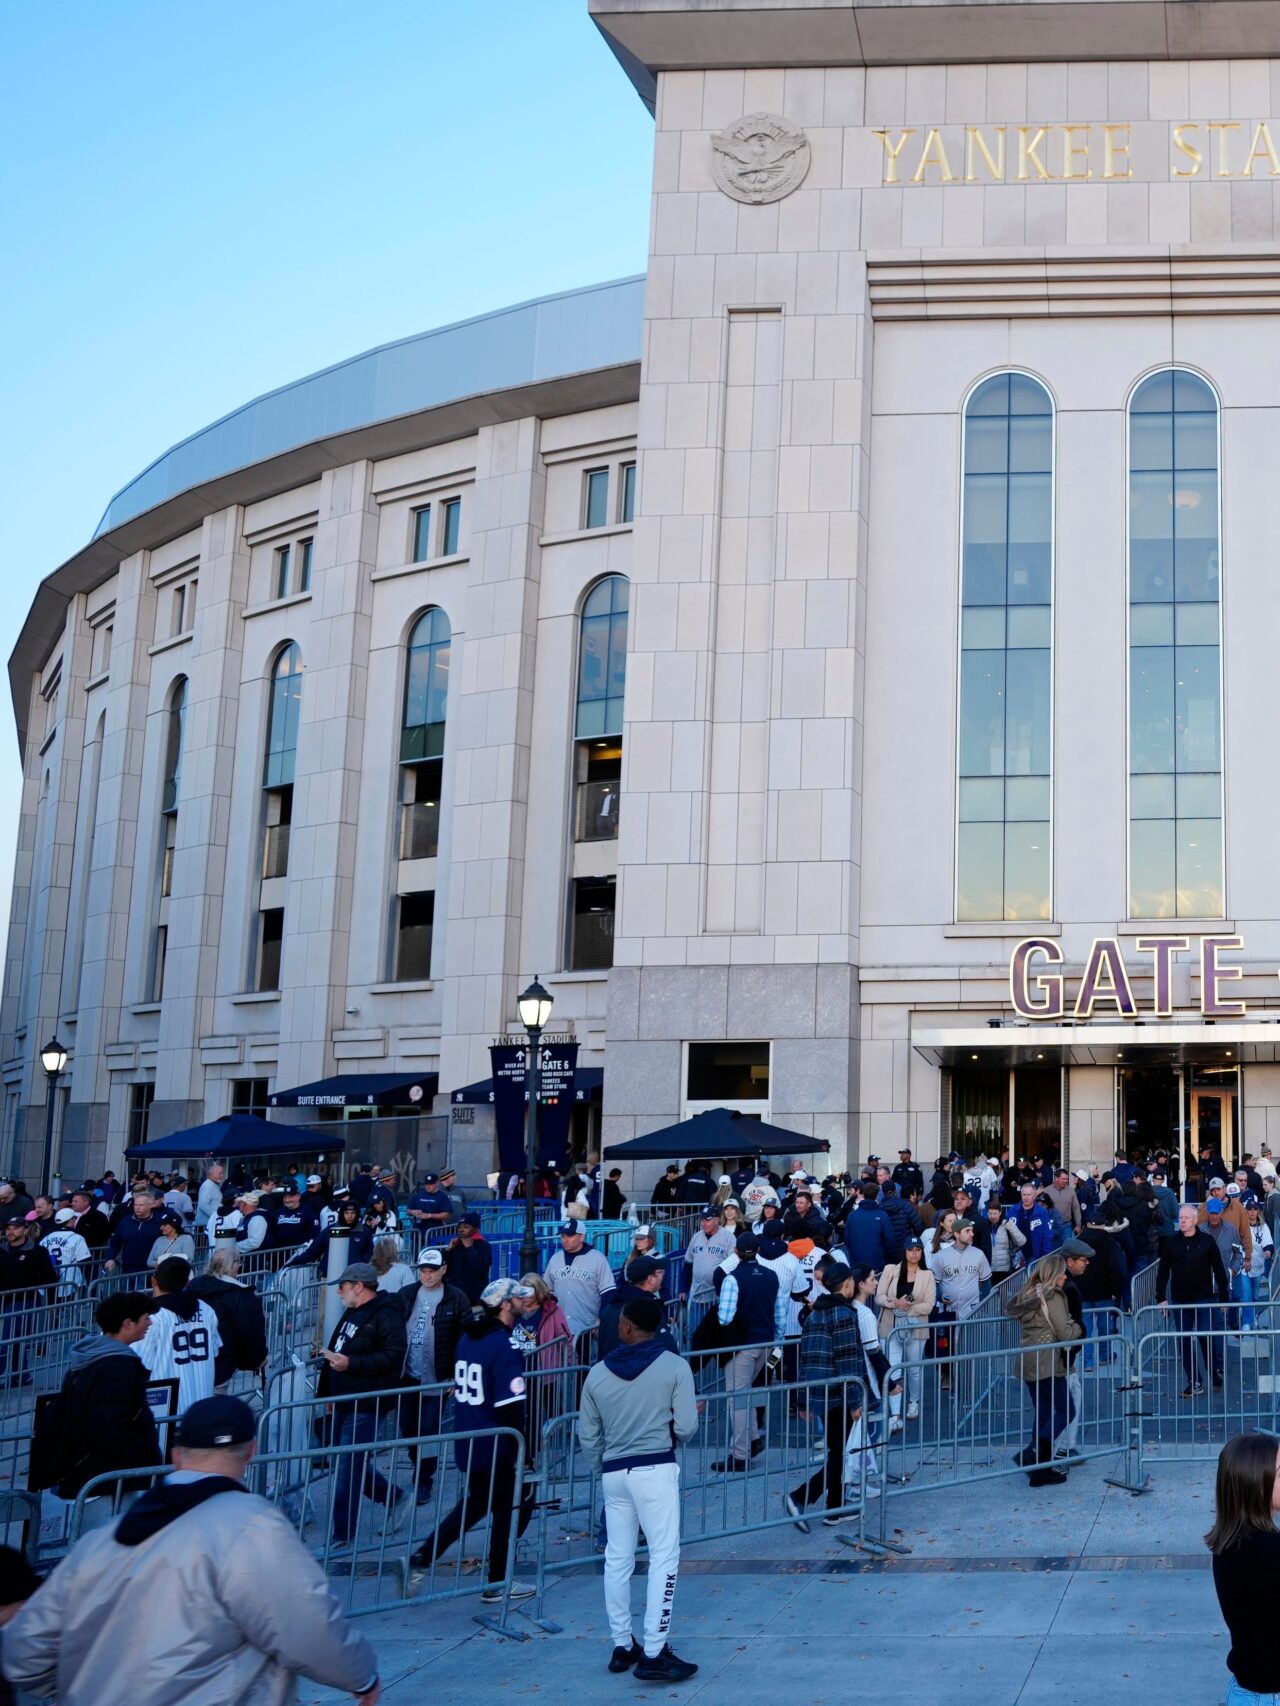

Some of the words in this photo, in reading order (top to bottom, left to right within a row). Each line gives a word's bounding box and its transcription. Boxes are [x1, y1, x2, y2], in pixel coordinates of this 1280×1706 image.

[870, 124, 1134, 184] YANKEE
[1010, 935, 1247, 1019] GATE
[492, 1036, 526, 1046] YANKEE
[543, 1034, 577, 1044] STADIUM
[542, 1061, 562, 1070] GATE
[564, 1060, 569, 1069] 6
[298, 1096, 315, 1105] SUITE
[316, 1096, 346, 1105] ENTRANCE
[452, 1108, 476, 1119] SUITE
[692, 1246, 703, 1254] NEW
[708, 1246, 725, 1255] YORK
[571, 1268, 593, 1281] YORK
[172, 1327, 209, 1366] 99
[455, 1360, 485, 1406] 99
[663, 1574, 676, 1604] YORK
[658, 1609, 671, 1632] NEW
